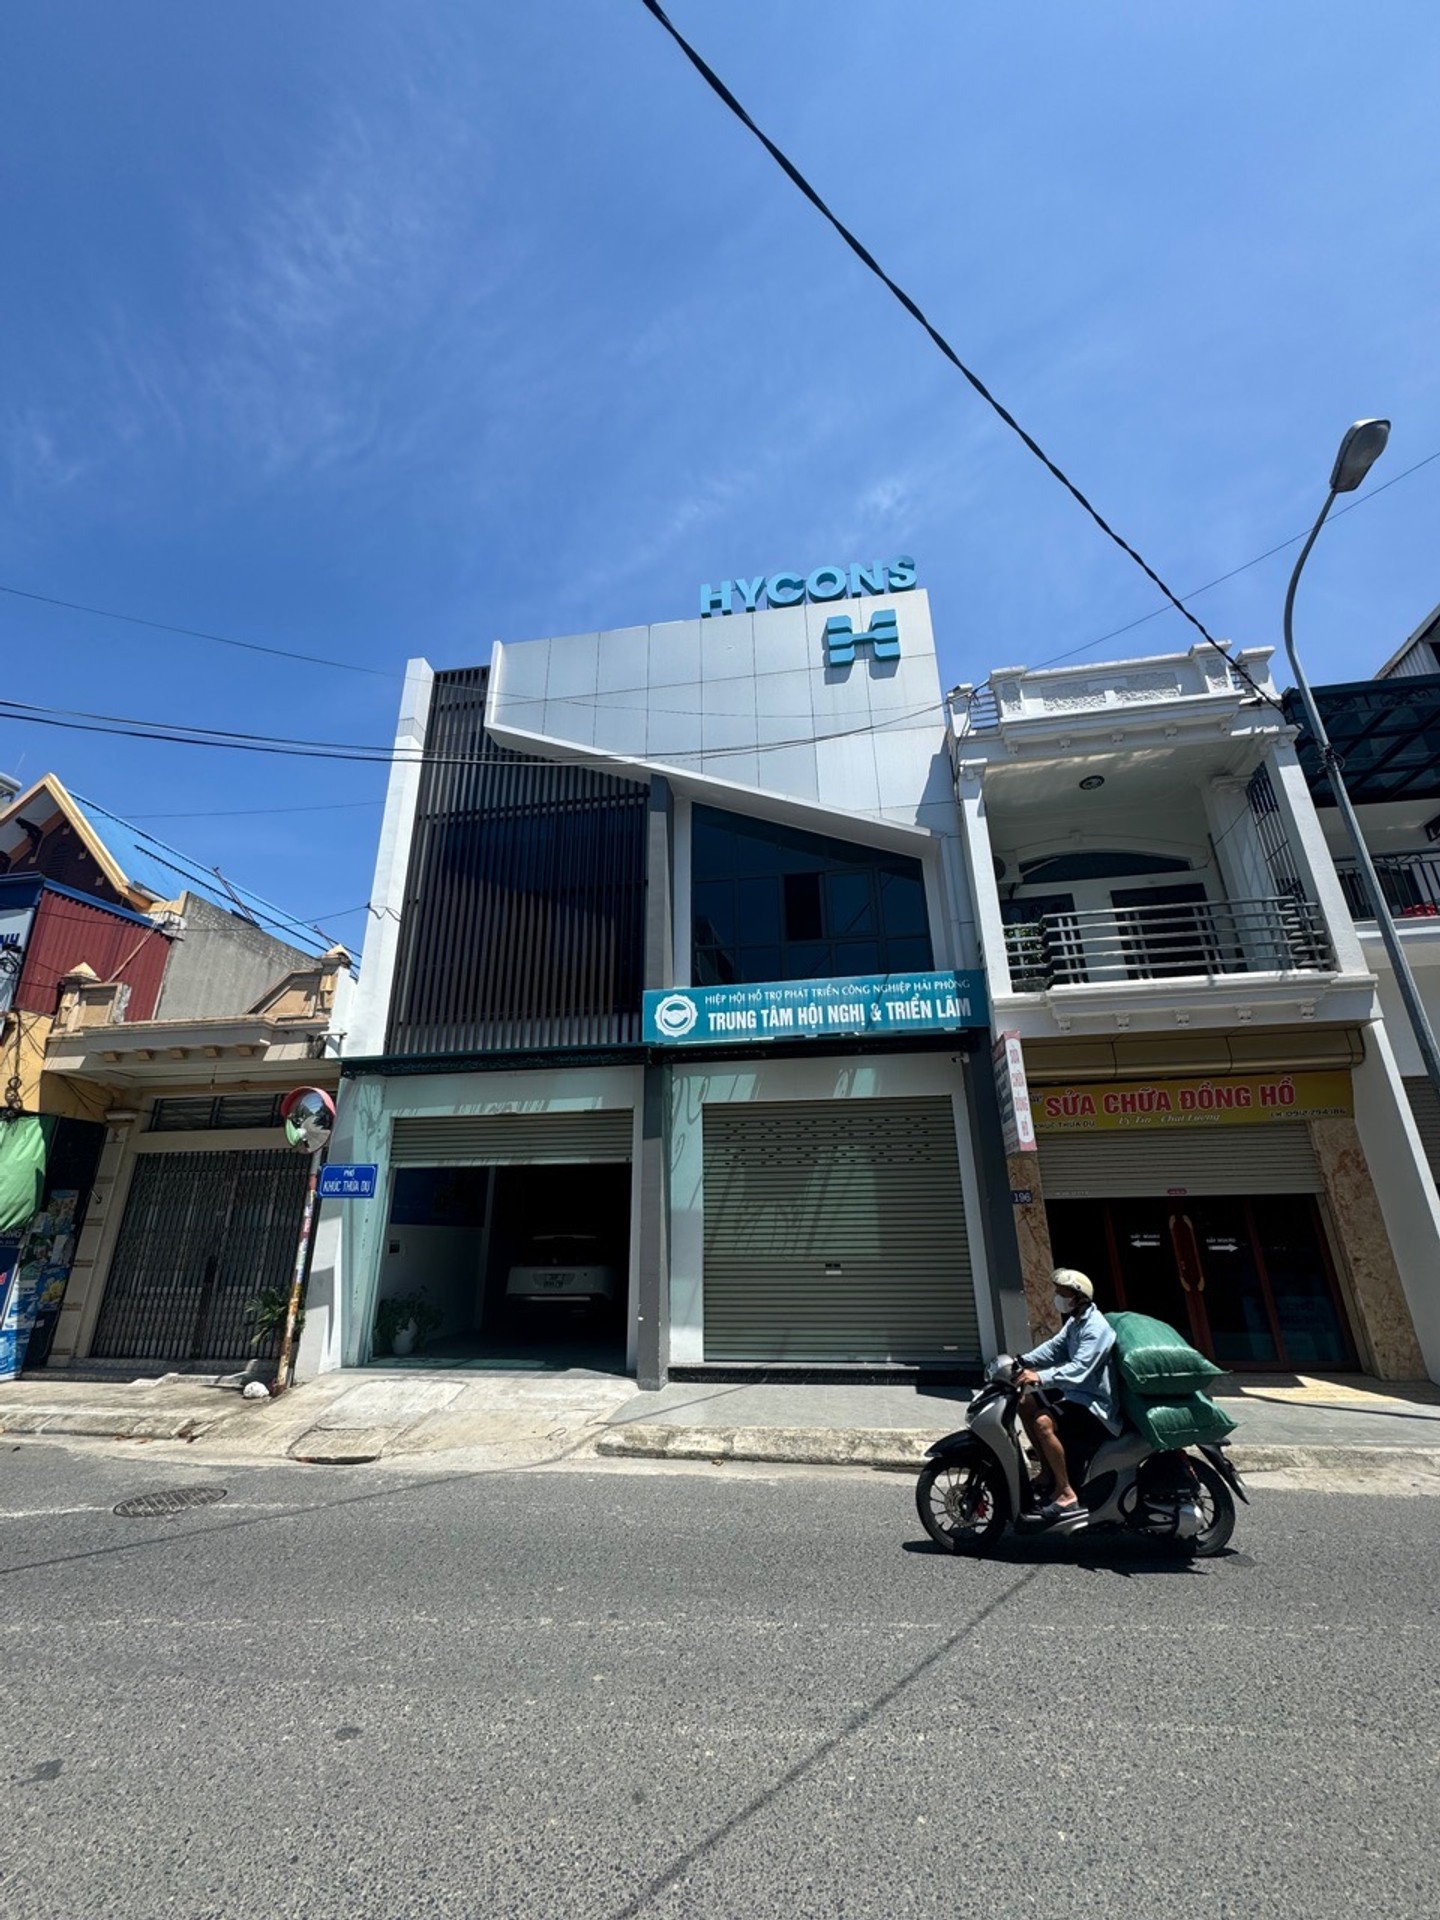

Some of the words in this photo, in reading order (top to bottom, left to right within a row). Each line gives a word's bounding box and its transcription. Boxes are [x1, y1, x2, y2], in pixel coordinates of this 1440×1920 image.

[701, 555, 918, 618] HYCONS
[705, 993, 726, 1007] HIỆP
[729, 991, 745, 1004] HỘI
[765, 989, 783, 1001] TRỢ
[785, 988, 808, 999] PHÁT
[842, 983, 870, 996] CÔNG
[873, 980, 911, 994] NGHIỆP
[914, 978, 931, 991] HẢI
[934, 978, 970, 991] PHÒNG
[708, 1010, 757, 1031] TRUNG
[761, 1005, 793, 1028] TÂM
[798, 1002, 823, 1028] HỘI
[827, 1003, 865, 1026] NGHỊ
[870, 1002, 882, 1021] &
[886, 993, 932, 1021] TRIỂN
[936, 995, 971, 1018] LÃM
[1046, 1088, 1096, 1117] SỬA
[1103, 1087, 1172, 1114] CHỮA
[323, 1177, 341, 1192] KHÚC
[342, 1177, 359, 1192] THỪA
[360, 1180, 371, 1193] DỤ
